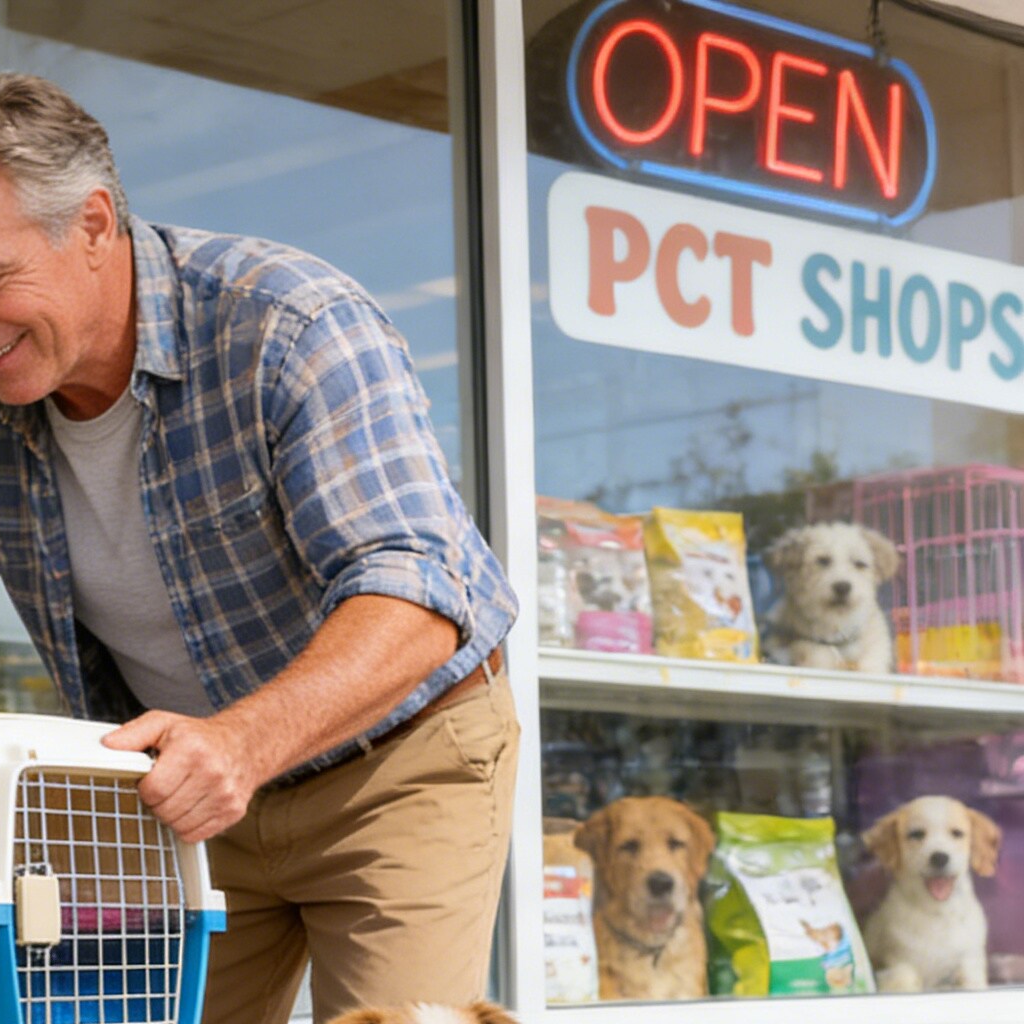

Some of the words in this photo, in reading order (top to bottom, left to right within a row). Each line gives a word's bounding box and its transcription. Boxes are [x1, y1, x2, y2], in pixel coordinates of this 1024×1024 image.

[593, 18, 903, 199] OPEN
[584, 205, 773, 337] PCT
[800, 252, 1024, 381] SHOPS
